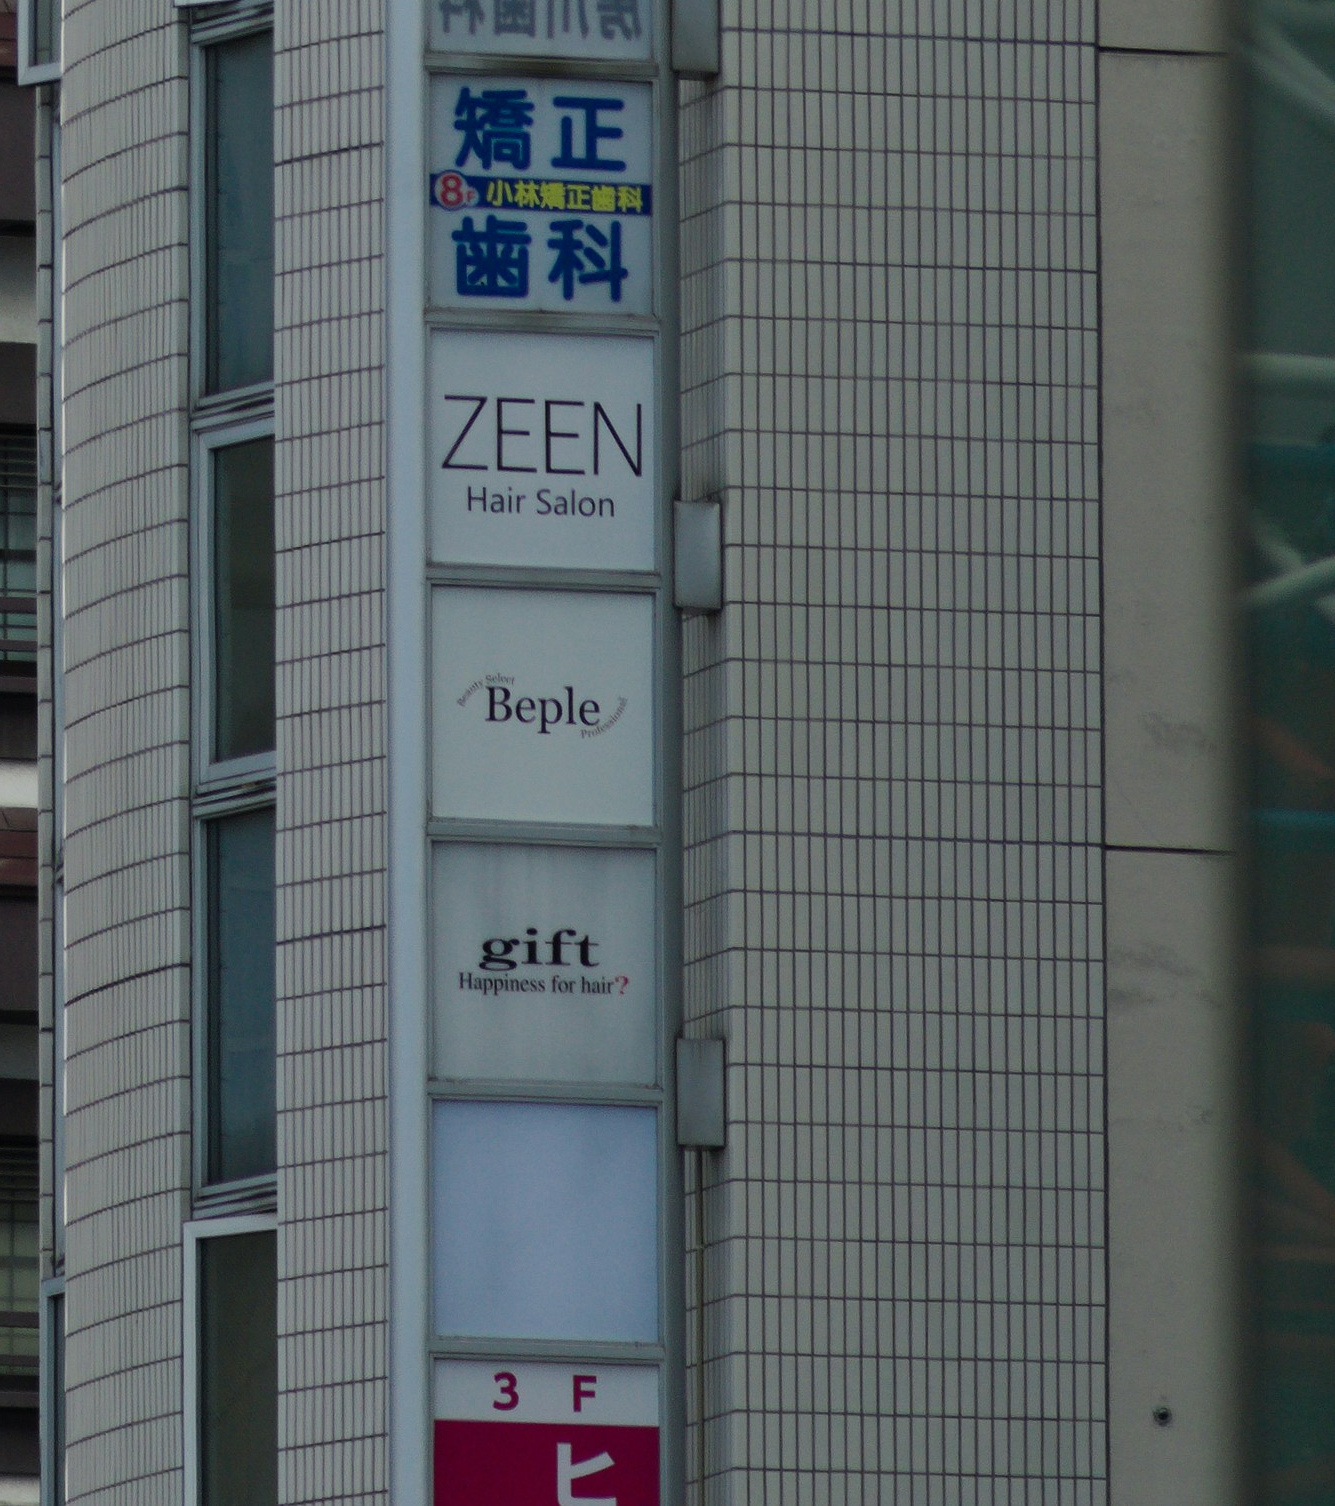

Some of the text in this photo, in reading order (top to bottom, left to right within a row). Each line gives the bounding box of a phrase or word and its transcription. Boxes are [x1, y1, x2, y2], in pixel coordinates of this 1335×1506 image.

[454, 86, 626, 172] 矯正
[486, 180, 643, 213] 小林矯正歯科
[451, 214, 628, 302] 歯科
[442, 394, 642, 477] ZEEN
[467, 486, 615, 518] Hair Salon
[485, 685, 601, 734] Beple
[580, 696, 629, 739] Professional
[479, 927, 600, 971] gift
[458, 972, 546, 996] Happiness
[552, 975, 576, 993] for
